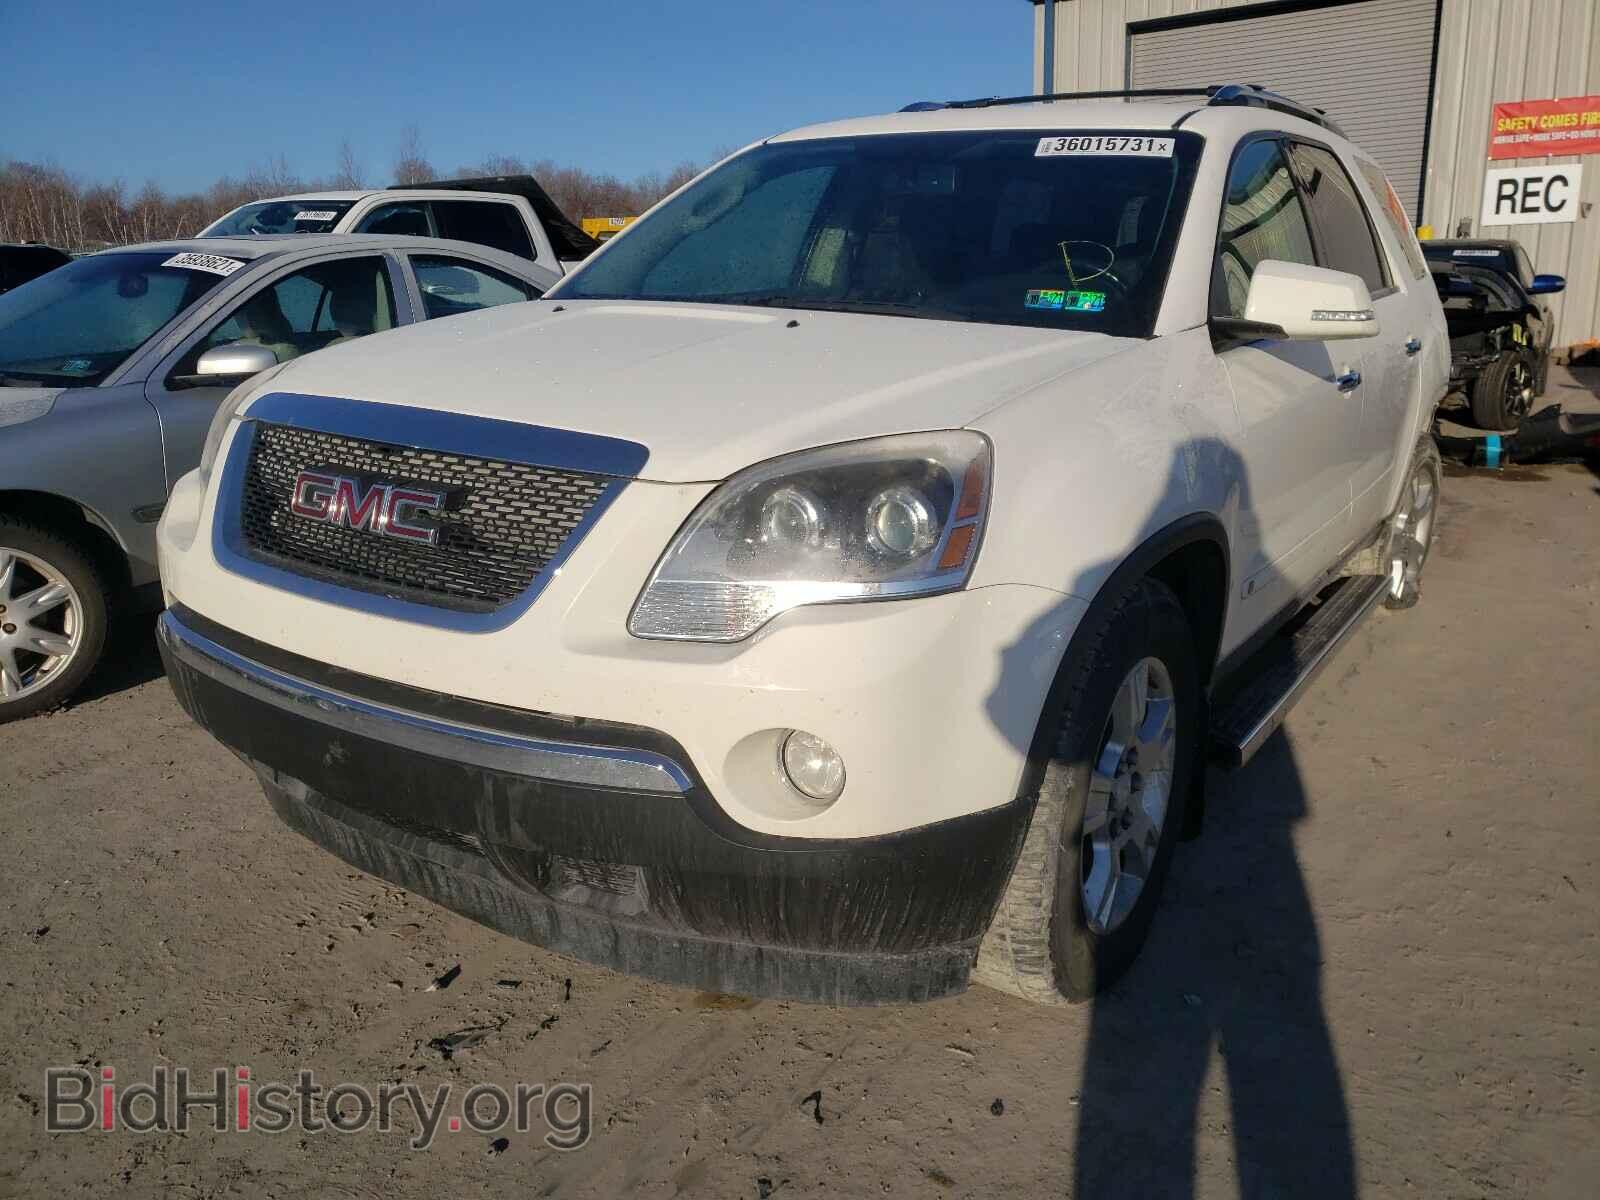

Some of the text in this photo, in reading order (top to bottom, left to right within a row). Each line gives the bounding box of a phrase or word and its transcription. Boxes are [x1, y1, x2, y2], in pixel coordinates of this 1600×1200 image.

[1497, 116, 1537, 132] SAFETY
[1540, 113, 1577, 129] COMES
[1054, 137, 1155, 152] 36015731
[1495, 174, 1569, 214] REC
[290, 470, 447, 545] GMC
